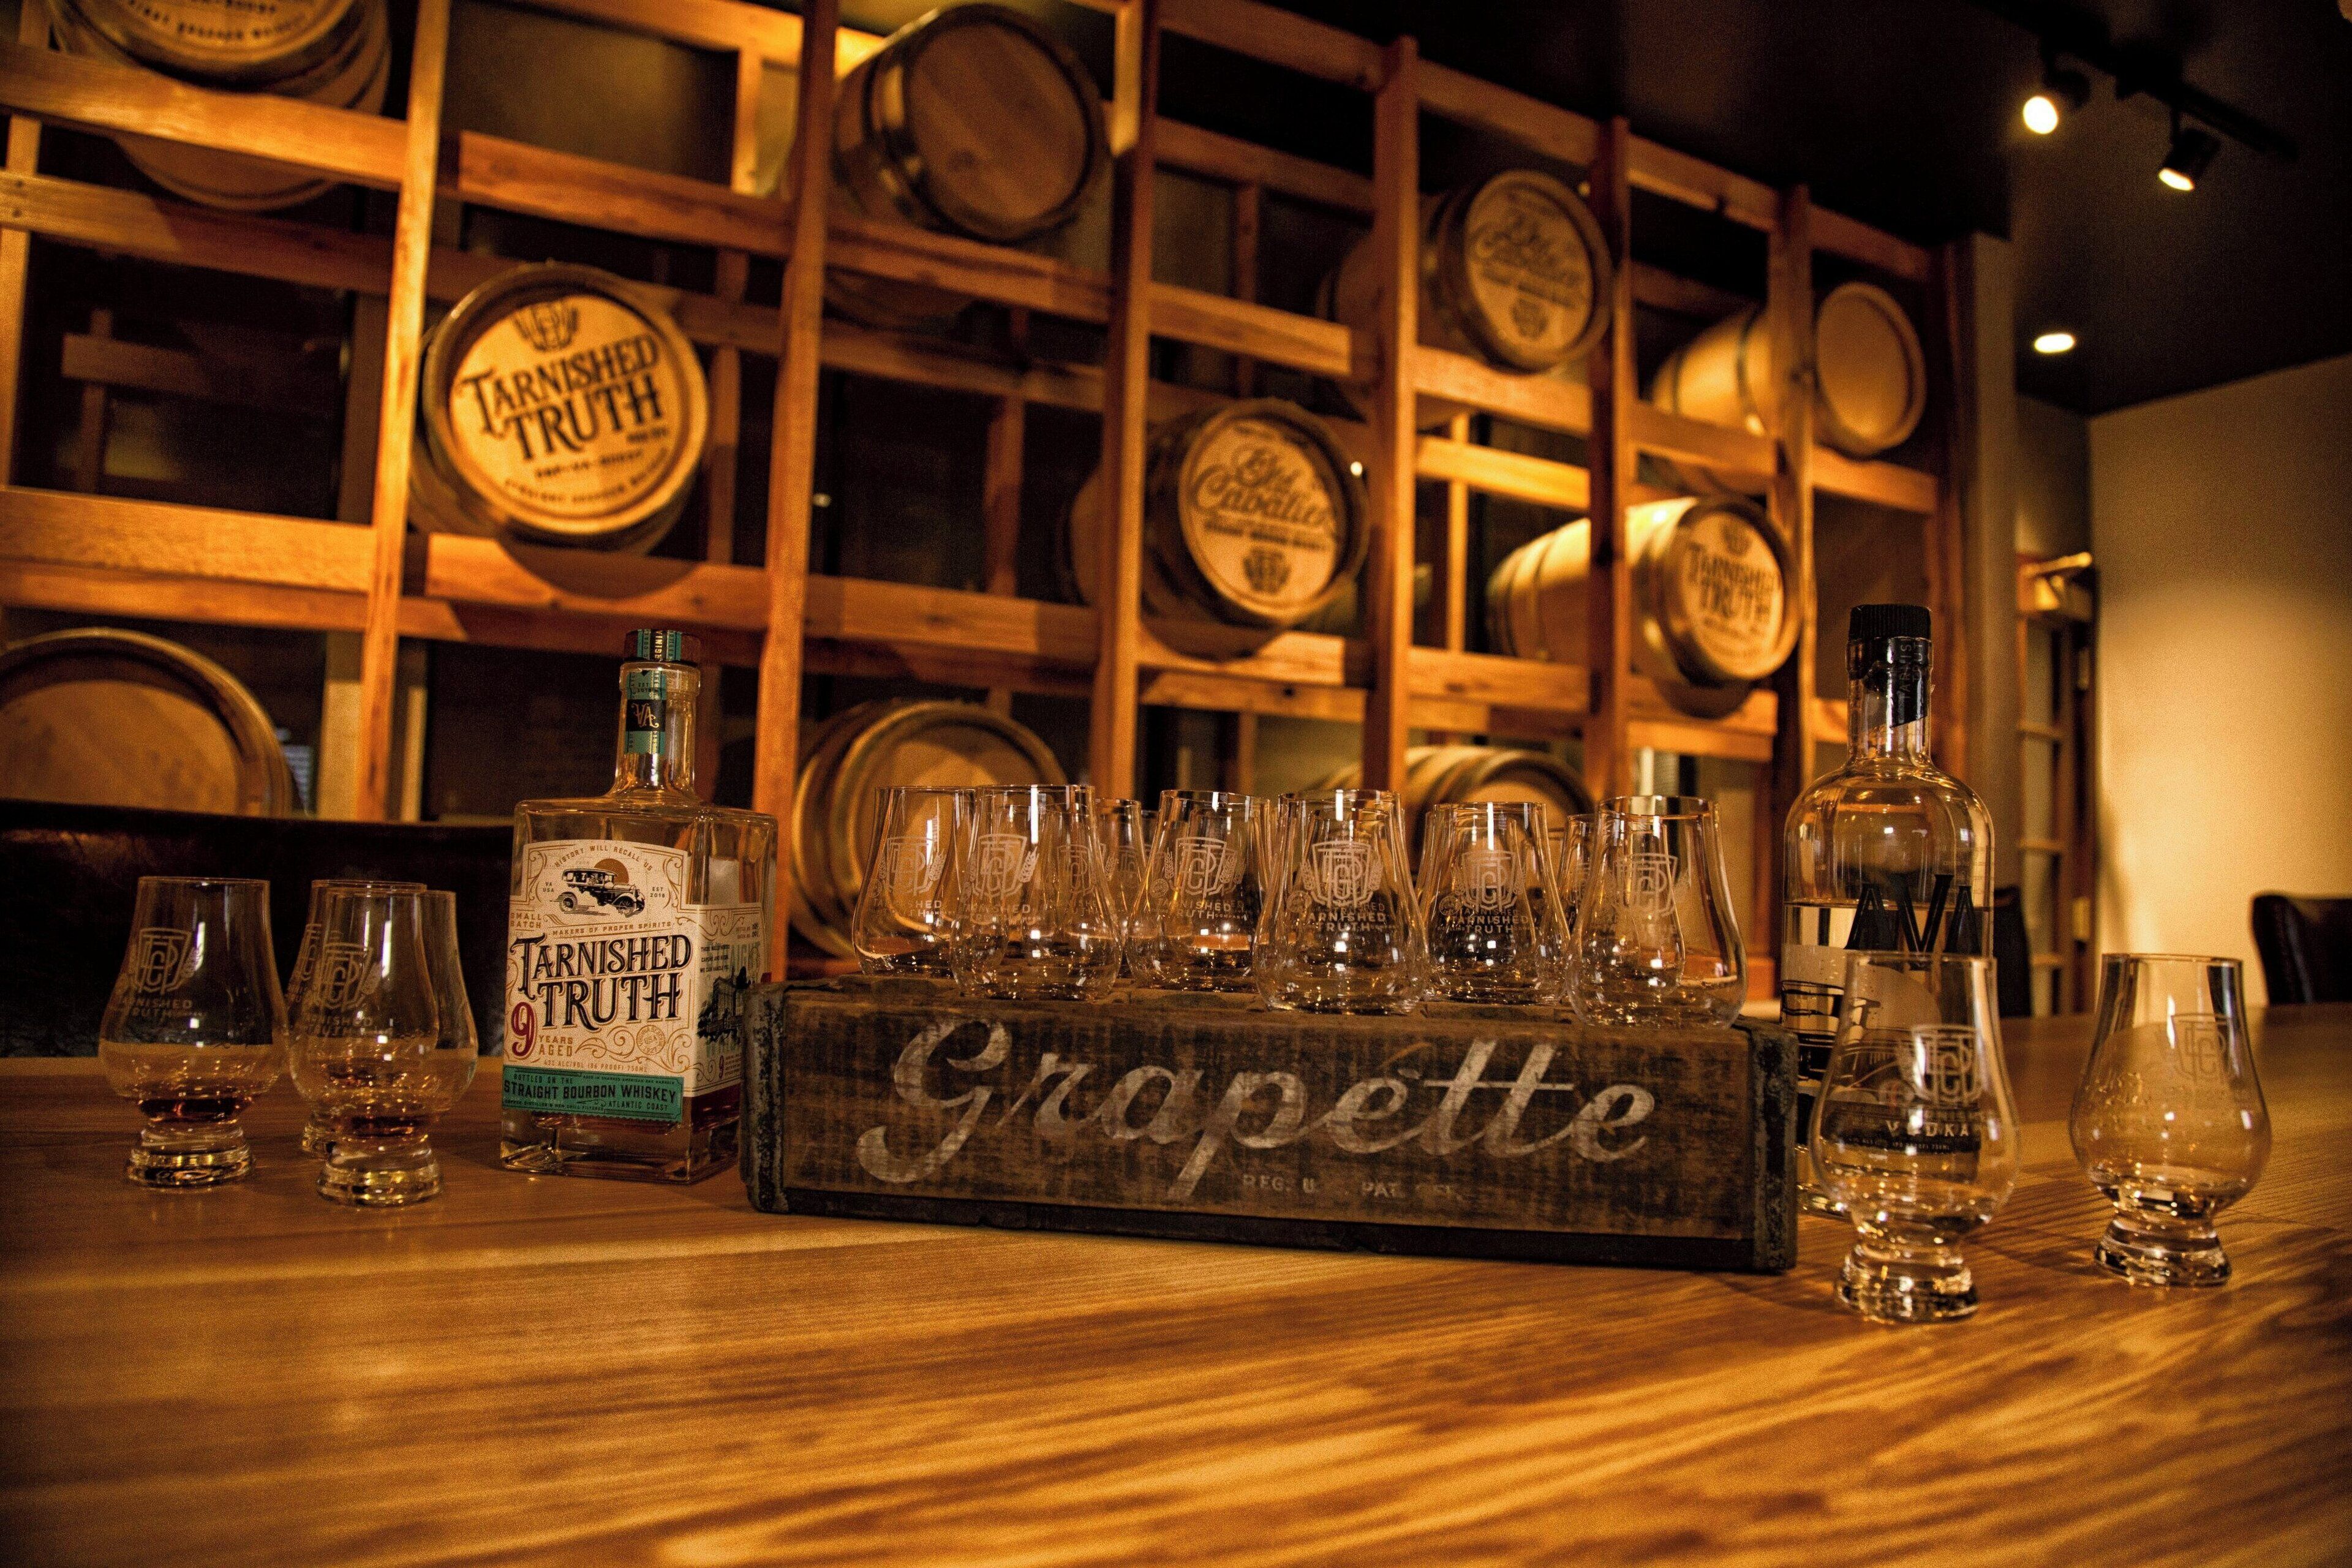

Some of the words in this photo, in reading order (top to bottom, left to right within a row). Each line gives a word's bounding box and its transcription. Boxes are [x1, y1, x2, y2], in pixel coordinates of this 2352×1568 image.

[459, 334, 659, 440] TARNISHED
[503, 374, 663, 463] TRUTH
[554, 848, 584, 867] HISTORY
[614, 846, 640, 862] RECALL
[644, 861, 654, 872] US
[1171, 910, 1215, 919] RUTH
[1298, 912, 1386, 922] ARNISHED
[1466, 925, 1513, 933] TRUTH
[510, 933, 693, 1000] TARNISHED
[537, 972, 683, 1031] TRUTH
[511, 1001, 538, 1058] 9
[538, 1035, 573, 1044] YEARS
[539, 1045, 573, 1057] AGED
[513, 1074, 543, 1083] BOTTLED
[504, 1080, 559, 1099] STRAIGHT
[563, 1085, 615, 1099] BOURBON
[621, 1085, 676, 1104] WHISKEY
[608, 1101, 642, 1109] ATLANTIC
[647, 1102, 668, 1111] COAST
[857, 1018, 1659, 1205] Grapette
